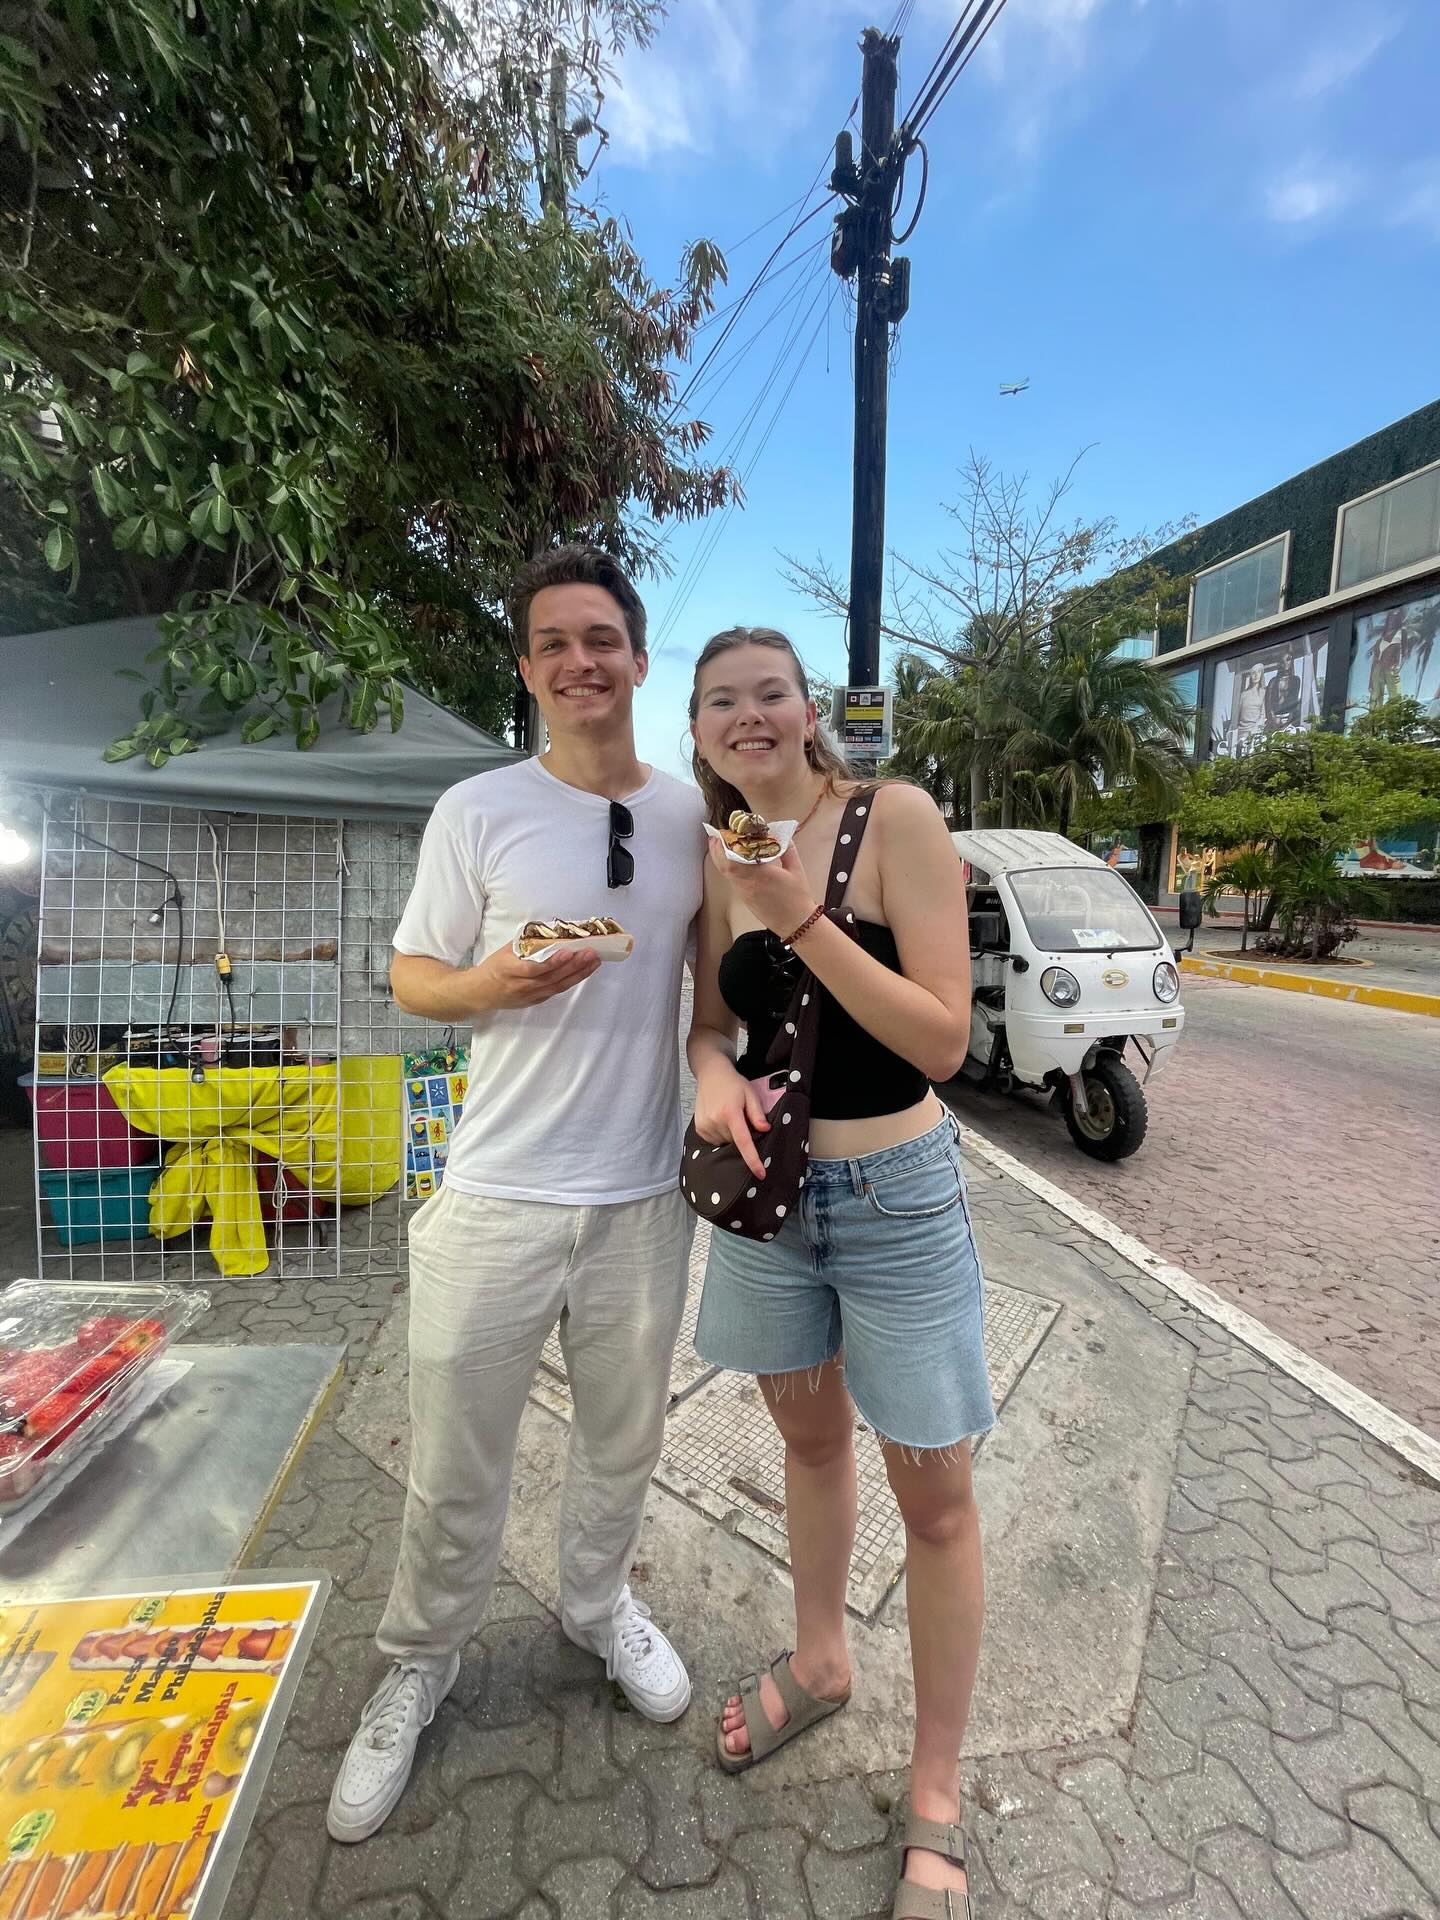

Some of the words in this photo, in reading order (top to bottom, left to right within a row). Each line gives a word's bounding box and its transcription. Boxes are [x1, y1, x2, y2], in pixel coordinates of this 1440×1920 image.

[107, 1654, 148, 1706] Fresa
[134, 1637, 180, 1704] Mango
[160, 1590, 227, 1701] Philadelphia
[149, 1731, 193, 1805] Mango
[175, 1681, 239, 1803] Philadelphia
[121, 1758, 157, 1809] Kiwi
